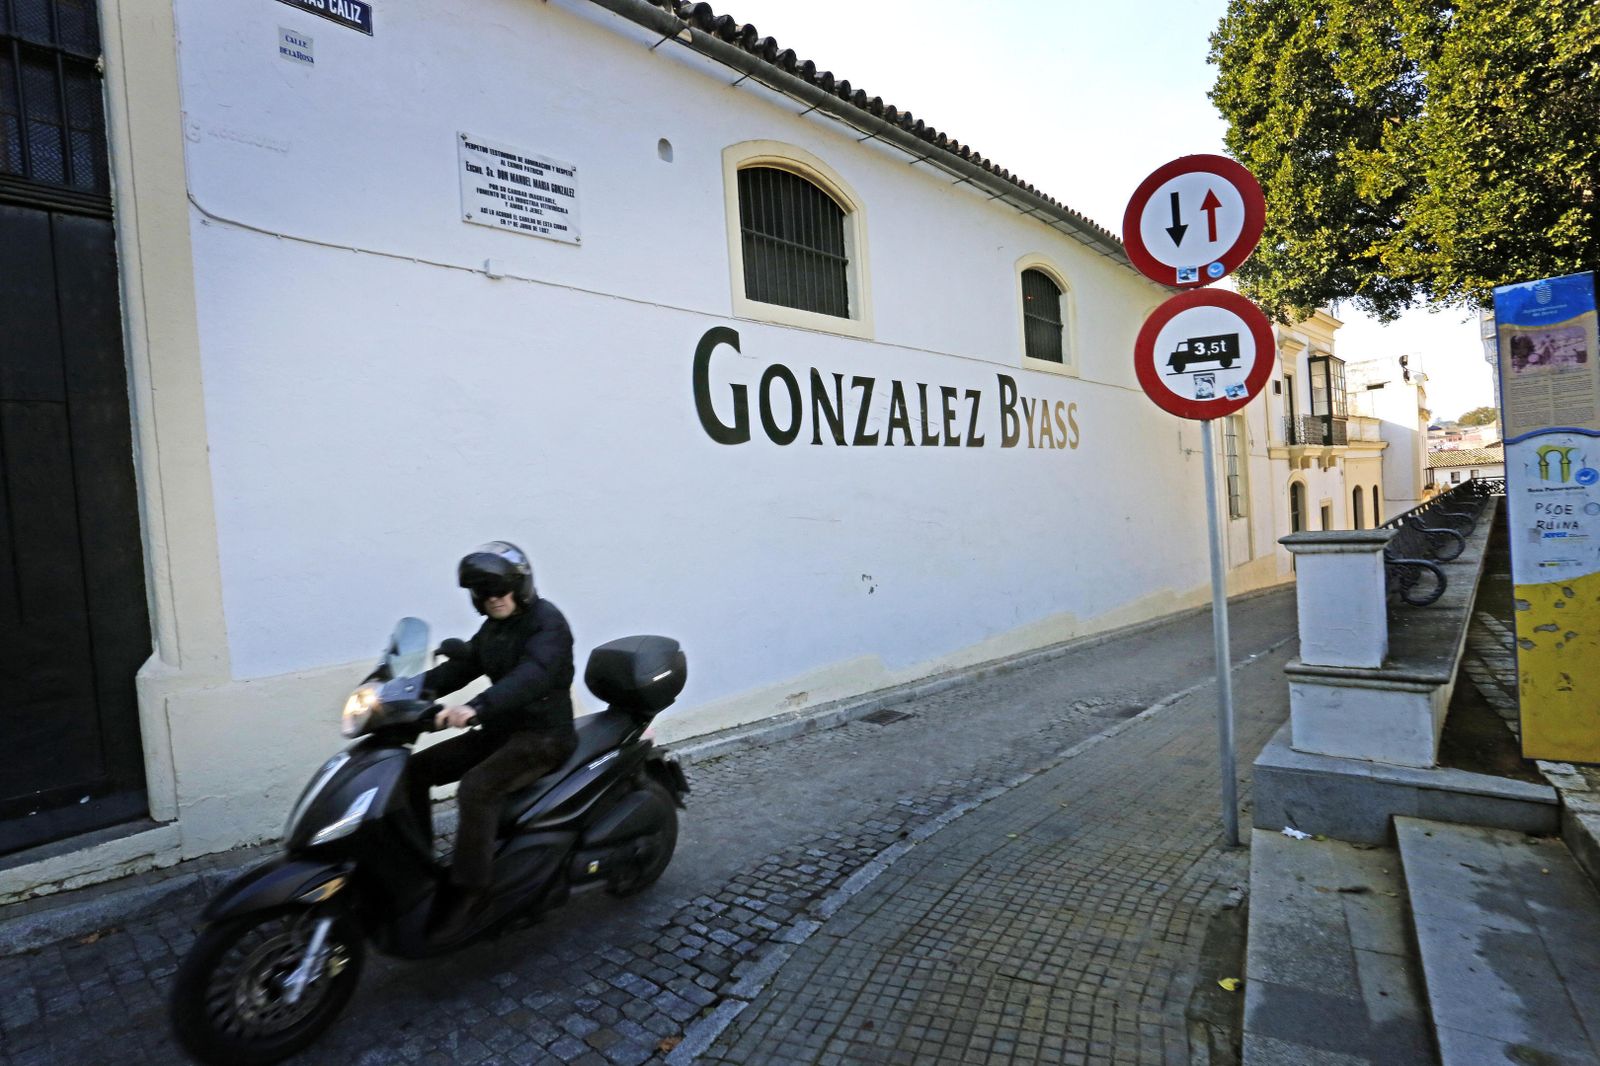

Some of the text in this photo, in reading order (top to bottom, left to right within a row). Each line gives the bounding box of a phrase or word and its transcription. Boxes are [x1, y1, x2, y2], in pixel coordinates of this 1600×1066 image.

[329, 0, 362, 24] CALIZ
[285, 34, 308, 49] CALLE
[465, 142, 488, 154] PERPETUO
[556, 167, 573, 177] RESPETO
[497, 169, 509, 181] DON
[510, 173, 531, 187] MANUEL
[477, 188, 499, 198] FOMENTO
[1194, 340, 1226, 356] 3,5t
[693, 326, 1080, 450] GONZALEZ BYASS
[1535, 502, 1573, 515] PSOE
[1536, 520, 1579, 530] RUINA
